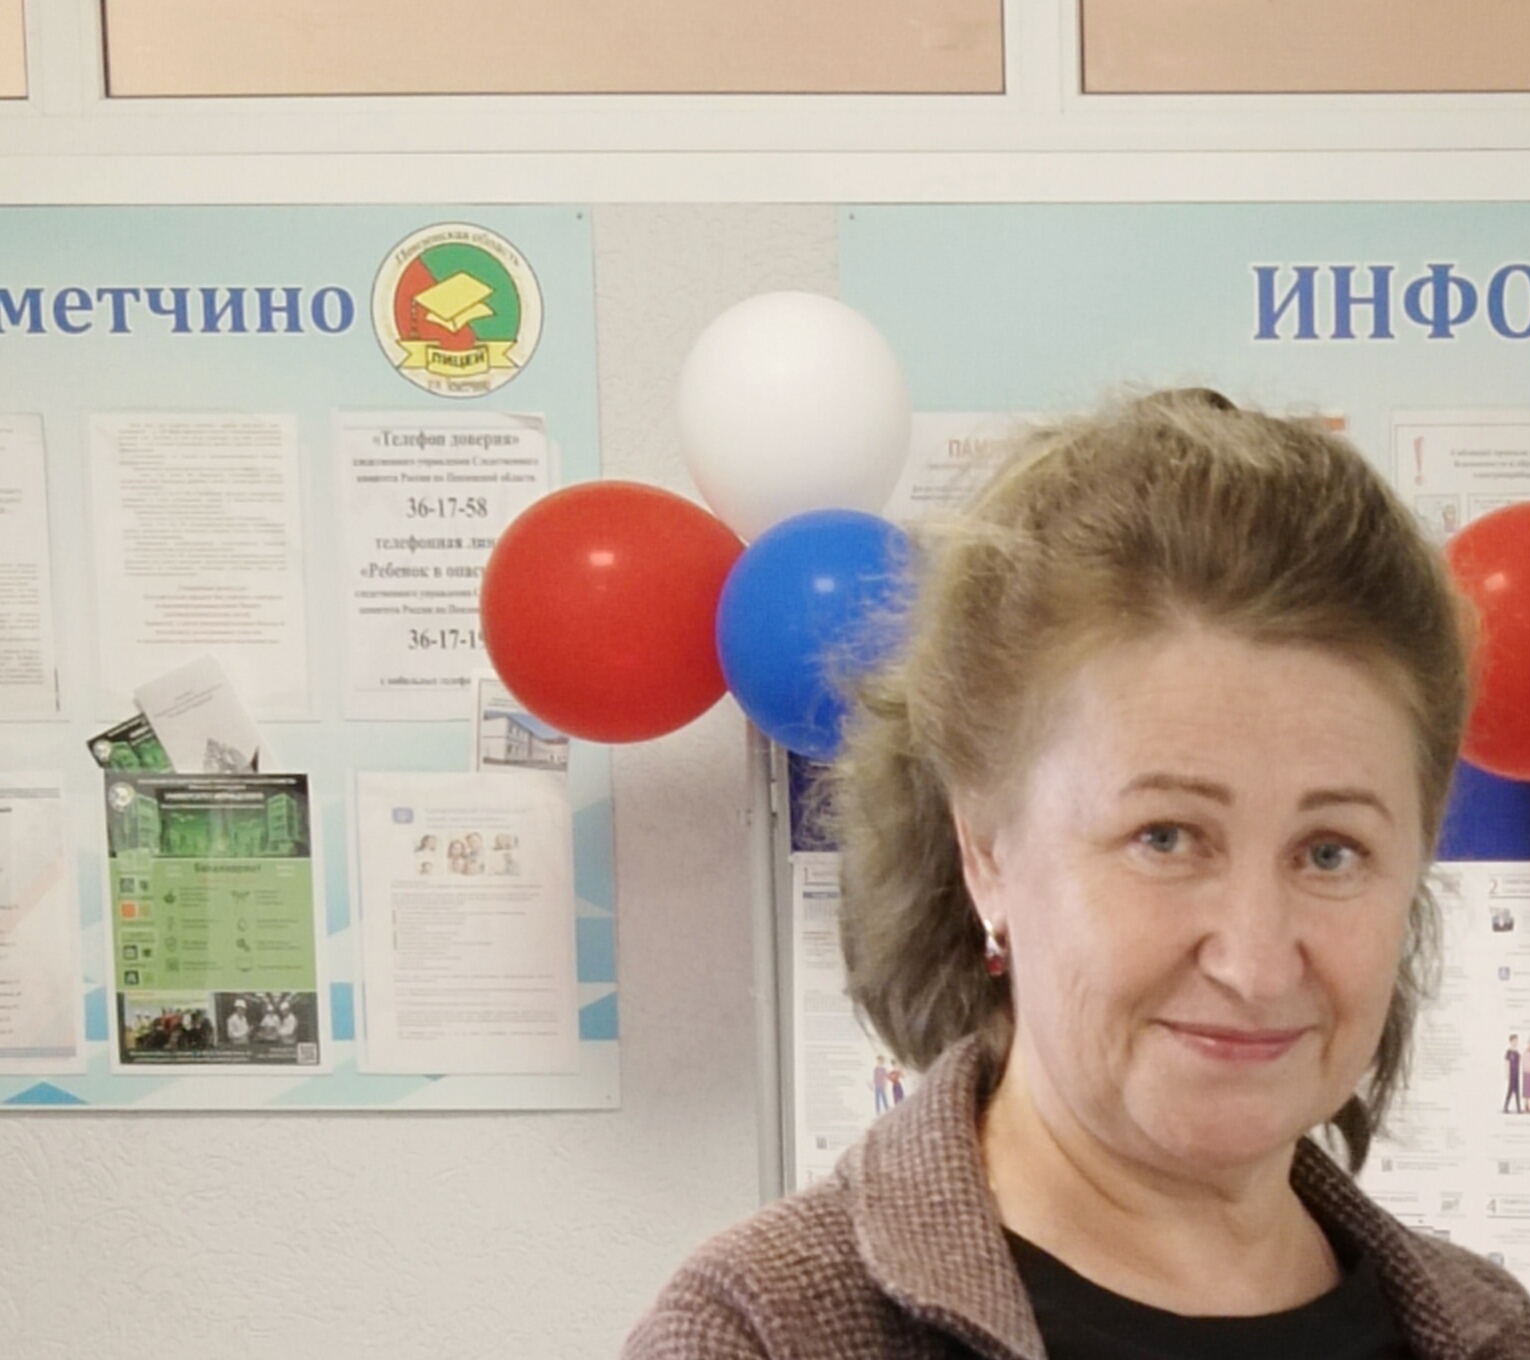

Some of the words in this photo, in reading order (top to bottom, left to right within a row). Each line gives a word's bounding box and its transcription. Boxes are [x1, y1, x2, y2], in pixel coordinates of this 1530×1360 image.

[0, 286, 356, 334] метчино
[406, 497, 488, 519] 36-17-58
[360, 562, 429, 579] «Ребенок
[433, 567, 442, 578] в
